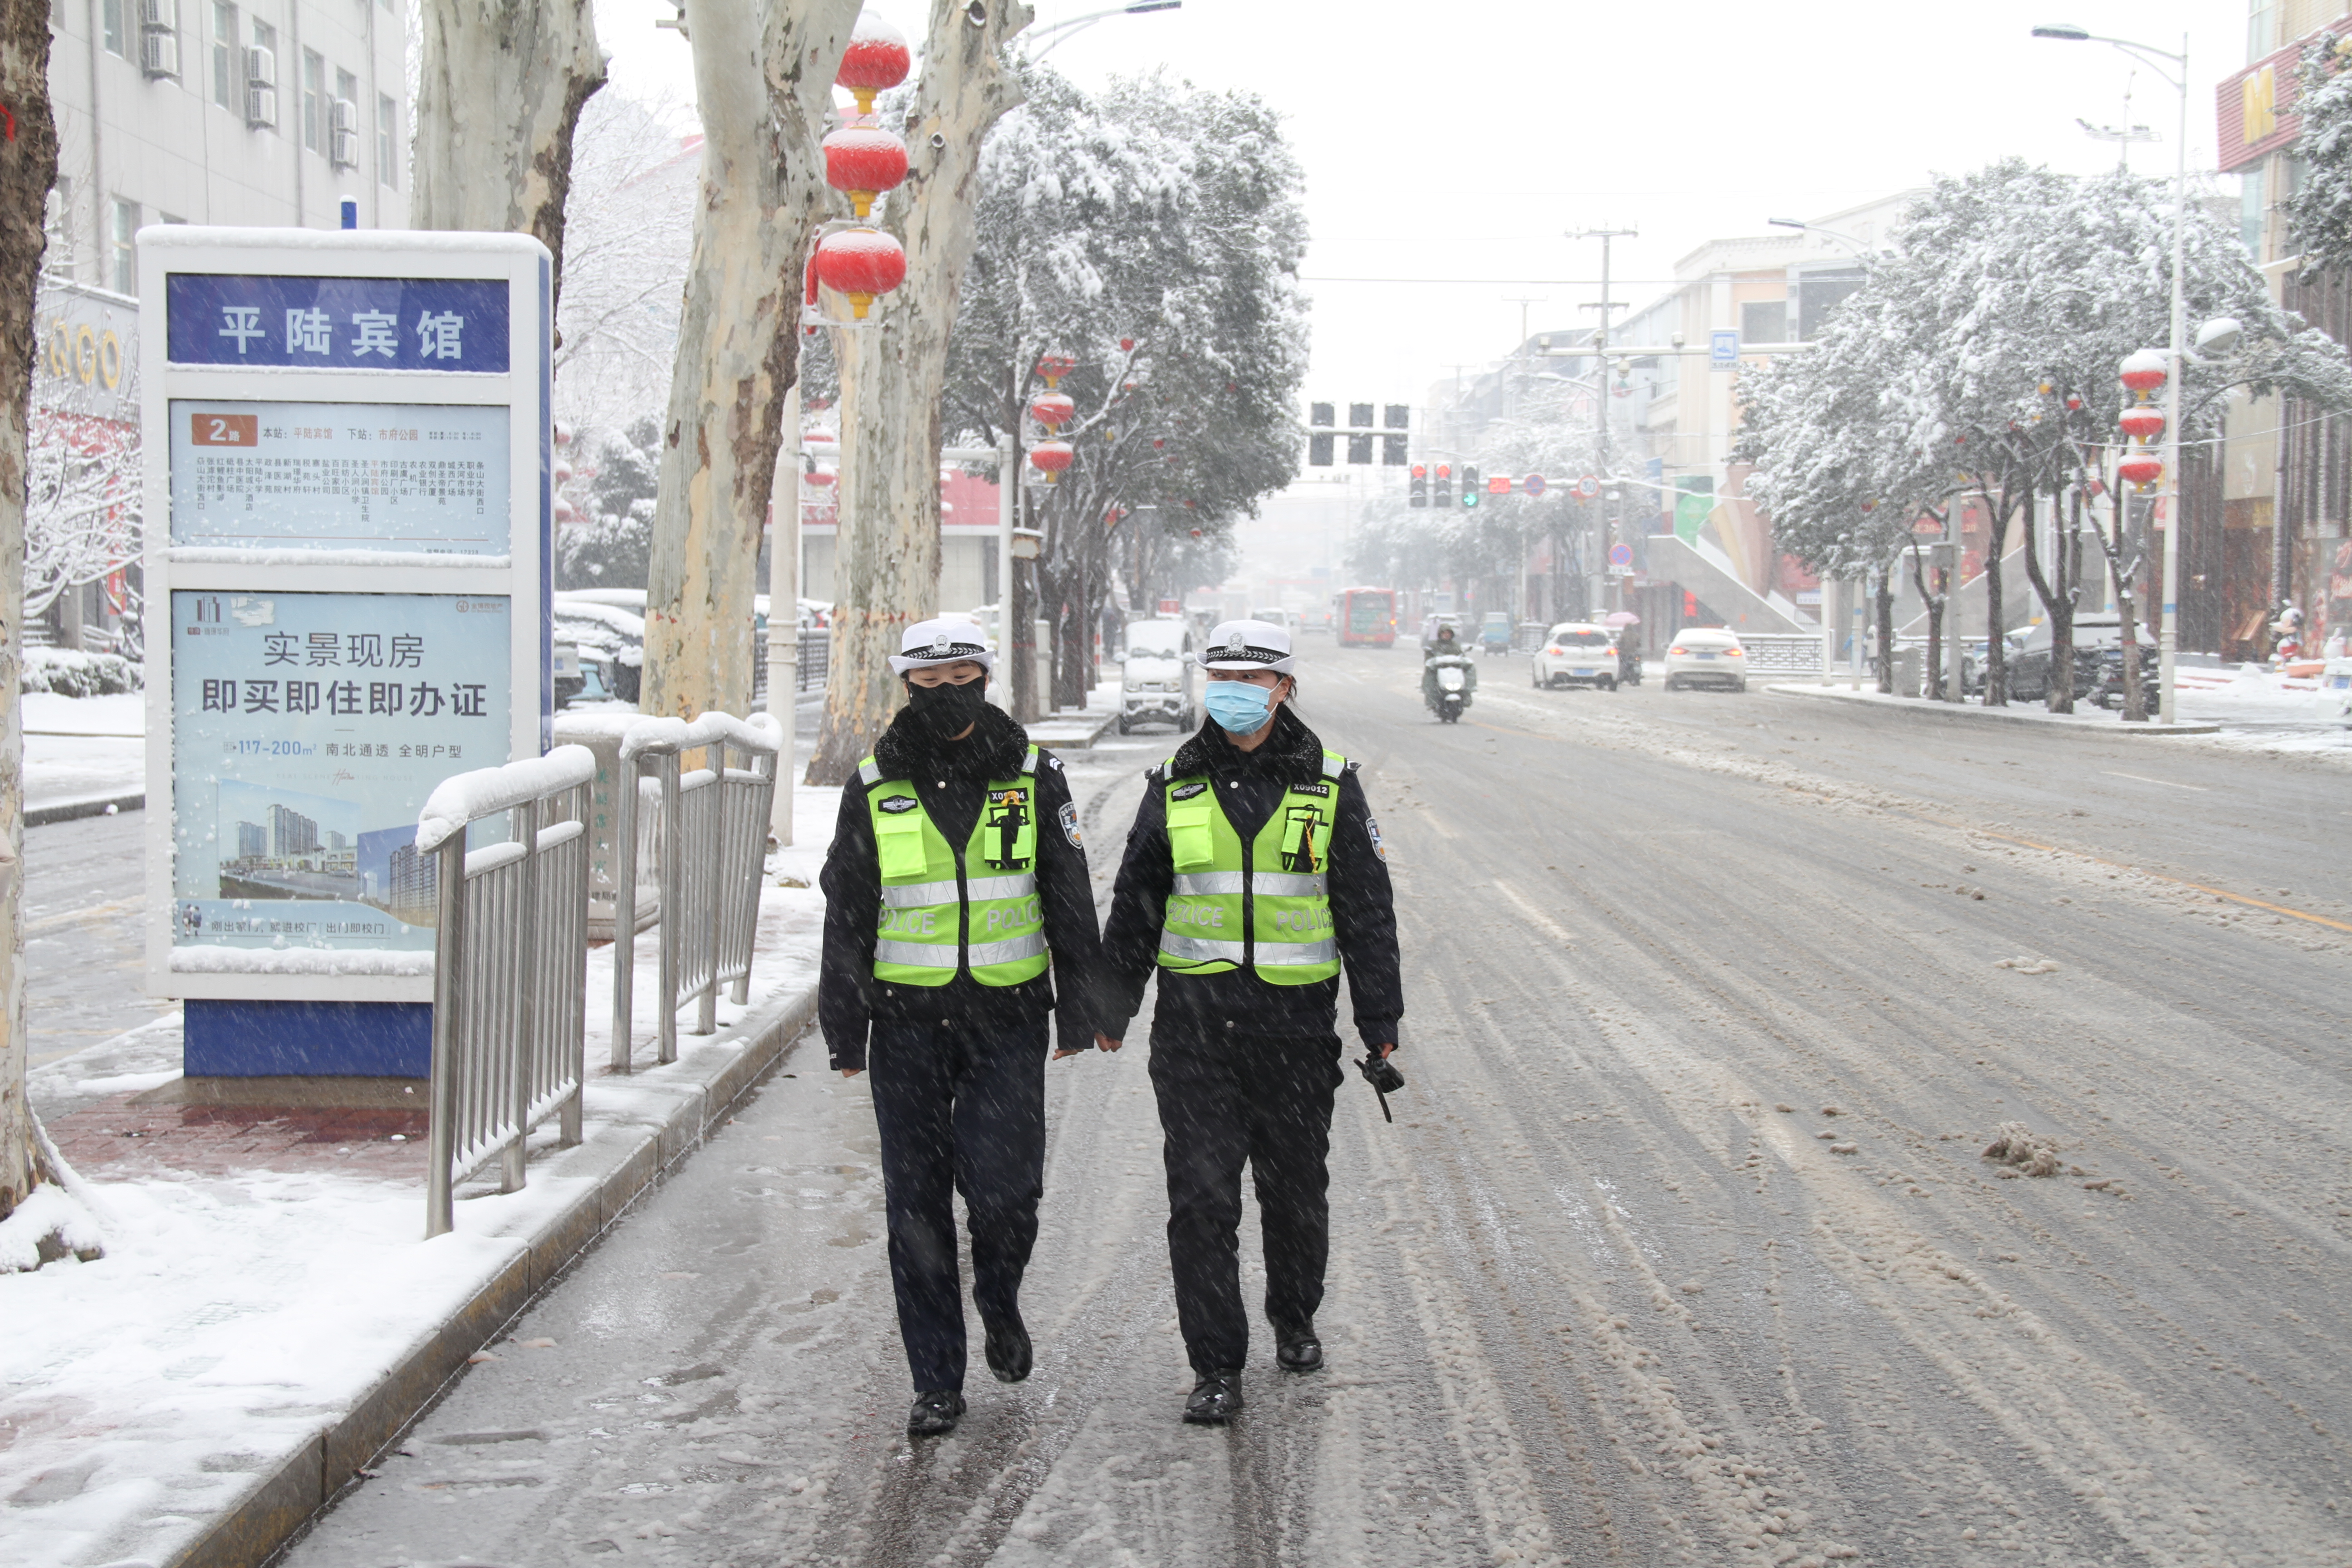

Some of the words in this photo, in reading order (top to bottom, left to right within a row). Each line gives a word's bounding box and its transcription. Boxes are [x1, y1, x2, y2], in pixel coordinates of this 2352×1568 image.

[219, 307, 464, 359] 平陆宾馆
[210, 419, 240, 442] 2路
[283, 458, 291, 494] 新湖村
[322, 459, 330, 495] 盐业公司
[332, 460, 340, 495] 百旺家园
[351, 460, 359, 504] 圣人涧小学
[361, 460, 369, 522] 圣人涧镇卫生院
[380, 460, 388, 495] 市府公园
[390, 461, 398, 505] 印刷厂小区
[409, 461, 417, 496] 农机厂
[457, 461, 465, 496] 天河市场
[466, 461, 475, 497] 职业中学
[1582, 481, 1597, 492] 30
[264, 631, 425, 668] 实景现房
[202, 679, 487, 717] 即买即住即办证
[326, 743, 389, 757] 南北通透
[398, 744, 462, 758] 全明户型
[1294, 783, 1328, 794] X09012
[877, 908, 936, 934] POLICE
[1167, 902, 1224, 927] POLICE
[1275, 907, 1333, 931] POLICE
